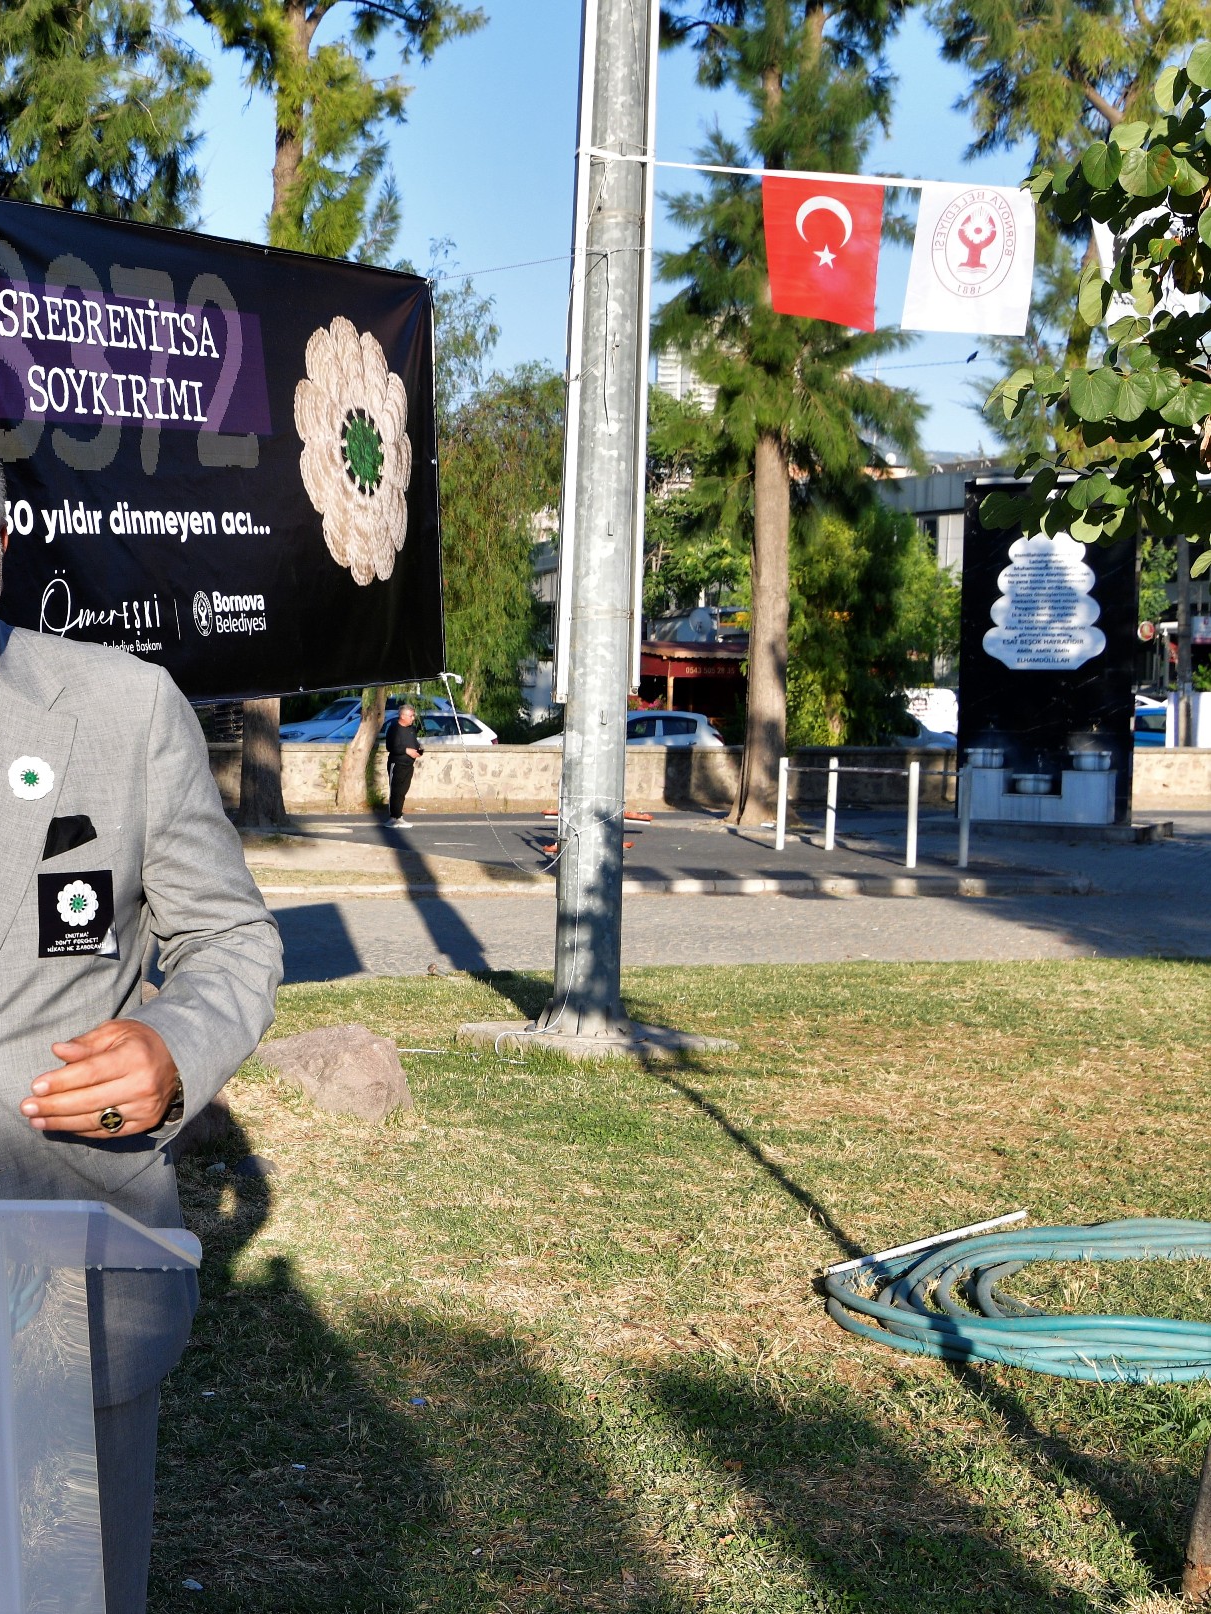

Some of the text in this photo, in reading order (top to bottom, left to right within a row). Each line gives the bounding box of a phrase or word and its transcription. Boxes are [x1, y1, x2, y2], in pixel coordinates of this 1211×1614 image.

[27, 365, 209, 423] SOYKIRIMI
[41, 499, 102, 543] yıldır
[109, 501, 217, 543] dinmeyen
[221, 511, 271, 535] acı...
[212, 591, 265, 613] Bornova
[215, 613, 267, 636] Belediyesi
[136, 639, 162, 653] Başkanı
